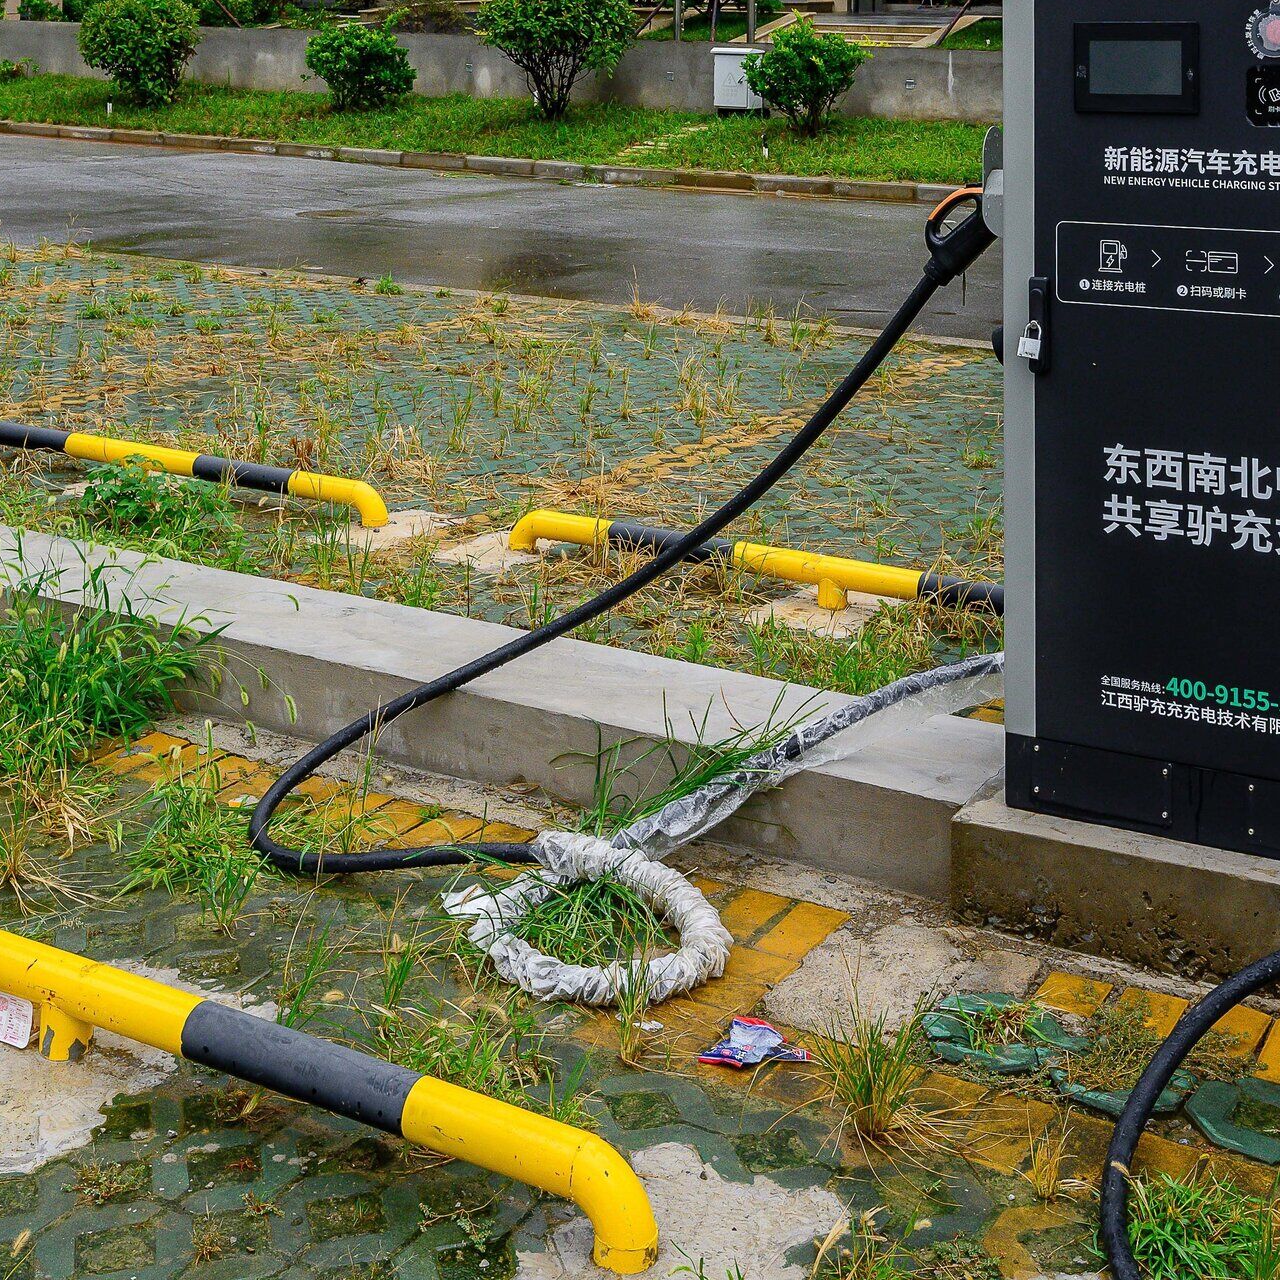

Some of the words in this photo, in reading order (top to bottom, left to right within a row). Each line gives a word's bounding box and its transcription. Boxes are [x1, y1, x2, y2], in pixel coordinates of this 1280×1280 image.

[1103, 176, 1126, 185] NEW
[1128, 177, 1166, 187] ENERGY
[1168, 178, 1210, 189] VEHICLE
[1212, 180, 1266, 191] CHARGING
[1091, 278, 1147, 294] 连接充电桩
[1190, 285, 1247, 300] 扫码或刷卡
